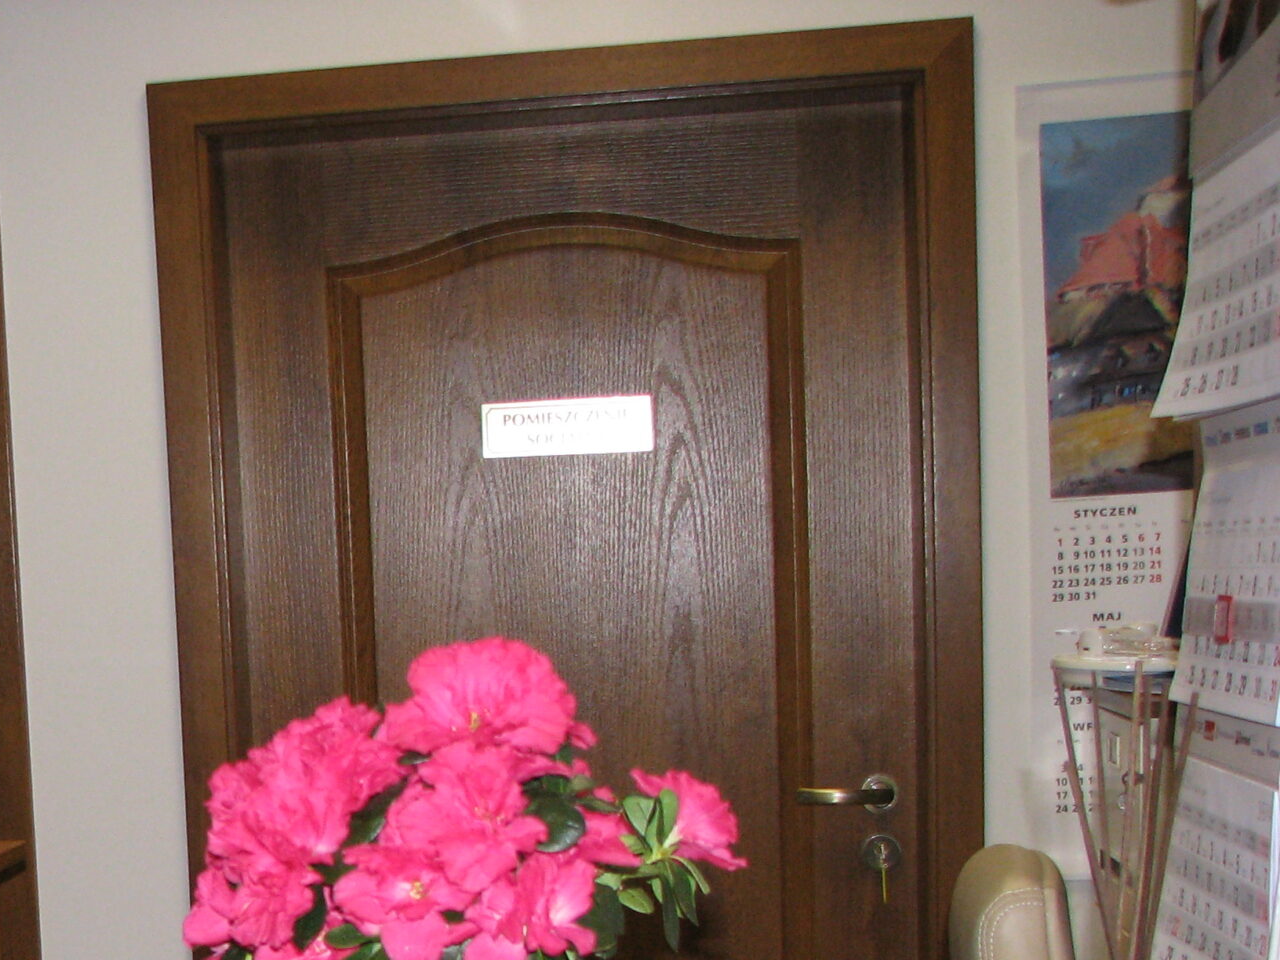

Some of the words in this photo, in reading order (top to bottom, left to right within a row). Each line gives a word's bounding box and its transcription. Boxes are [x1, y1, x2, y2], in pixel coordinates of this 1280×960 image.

[1057, 538, 1062, 547] 1
[1073, 537, 1079, 546] 2
[1089, 537, 1095, 545] 3
[1105, 535, 1112, 543] 4
[1122, 534, 1128, 543] 5
[1138, 533, 1144, 542] 6
[1155, 532, 1161, 541] 7
[1057, 552, 1064, 560] 8
[1073, 551, 1079, 560] 9
[1084, 550, 1096, 559] 10
[1100, 549, 1111, 558] 11
[1116, 548, 1128, 557] 12
[1133, 547, 1145, 556] 13
[1149, 547, 1161, 555] 14
[1052, 566, 1064, 575] 15
[1068, 565, 1079, 574] 16
[1084, 564, 1096, 573] 17
[1100, 563, 1112, 572] 18
[1116, 562, 1128, 571] 19
[1133, 561, 1145, 570] 20
[1149, 560, 1161, 569] 21
[1052, 580, 1064, 589] 22
[1067, 579, 1080, 588] 23
[1083, 578, 1096, 587] 24
[1100, 577, 1112, 586] 25
[1116, 576, 1129, 585] 26
[1133, 575, 1145, 584] 27
[1149, 574, 1162, 583] 28
[1052, 593, 1064, 602] 29
[1067, 592, 1080, 601] 30
[1084, 591, 1096, 600] 31
[1092, 612, 1122, 622] MAJ
[1070, 696, 1082, 705] 29
[1056, 777, 1068, 786] 10
[1056, 791, 1068, 800] 17
[1056, 804, 1068, 813] 24
